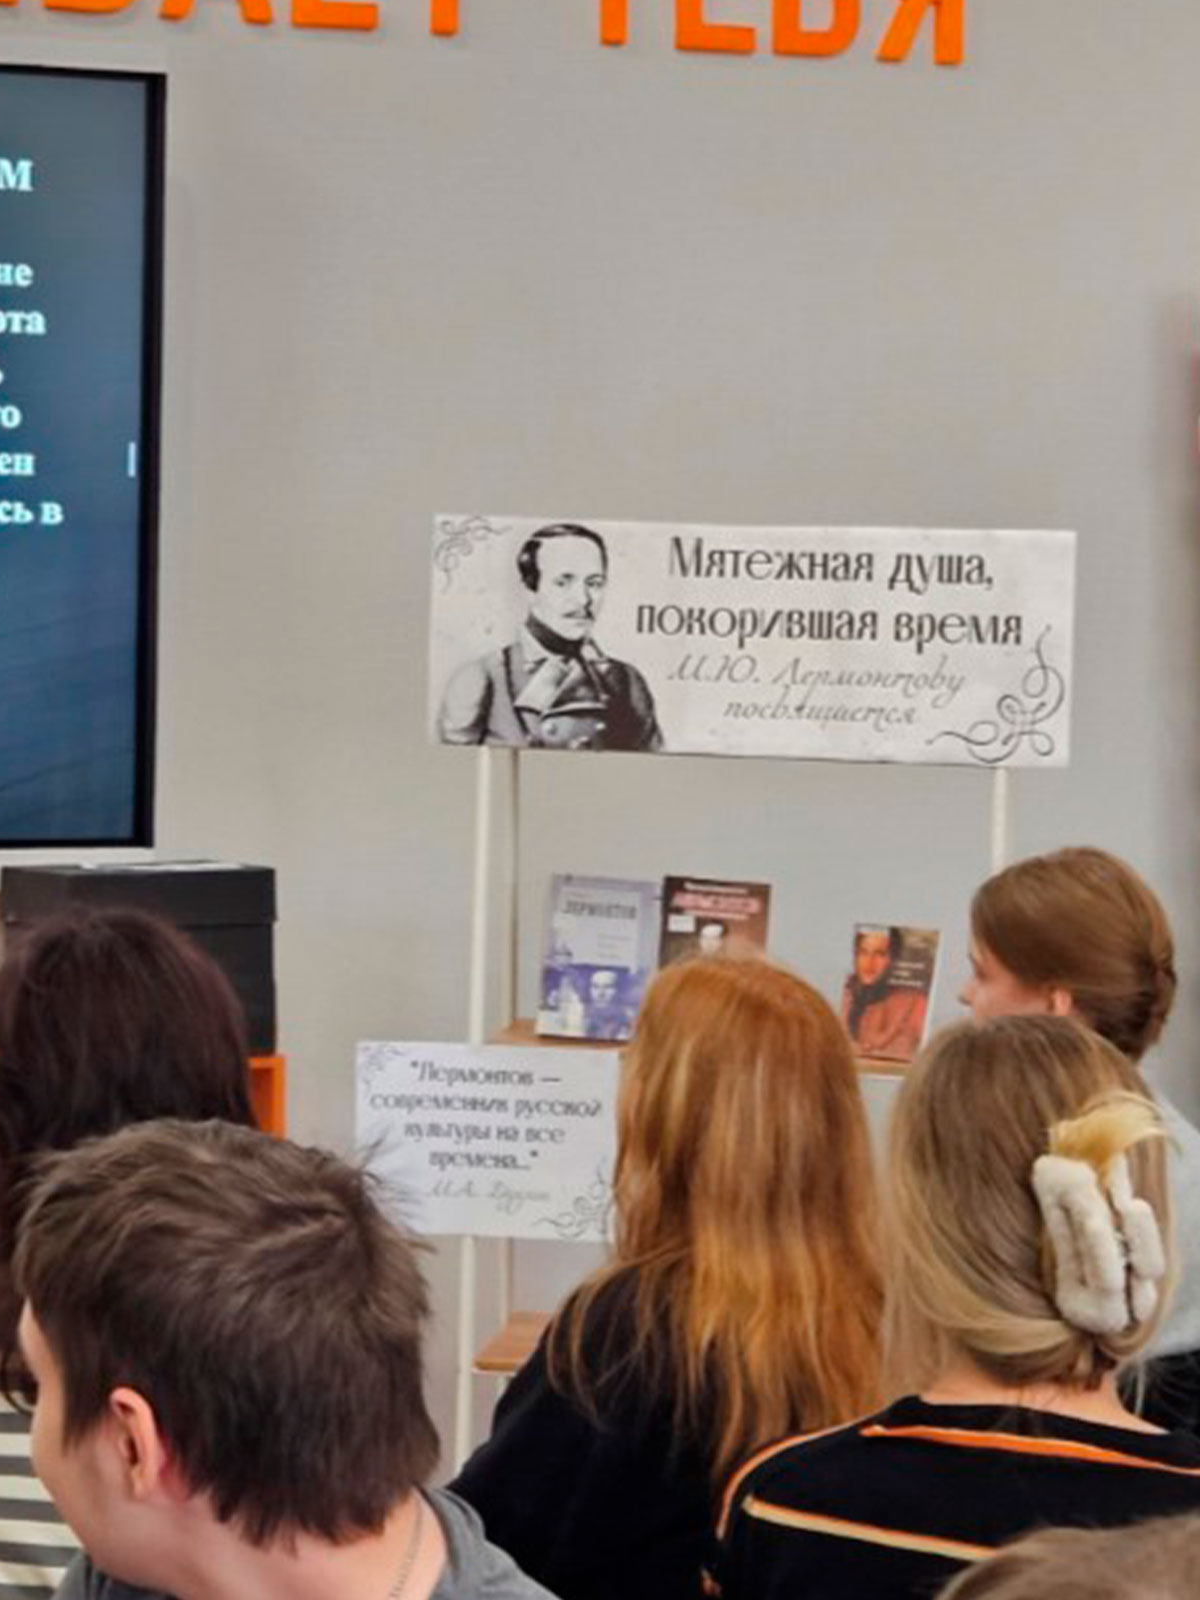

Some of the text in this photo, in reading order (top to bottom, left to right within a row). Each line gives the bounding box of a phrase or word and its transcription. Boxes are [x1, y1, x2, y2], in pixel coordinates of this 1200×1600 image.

[40, 501, 63, 525] в
[668, 536, 994, 594] Мятежная душа,
[635, 602, 1023, 653] покорившая время
[667, 653, 966, 709] М.Ю. Лермонтову
[723, 683, 917, 732] посвящается
[404, 1122, 566, 1144] культуры на все
[514, 1098, 602, 1119] русской
